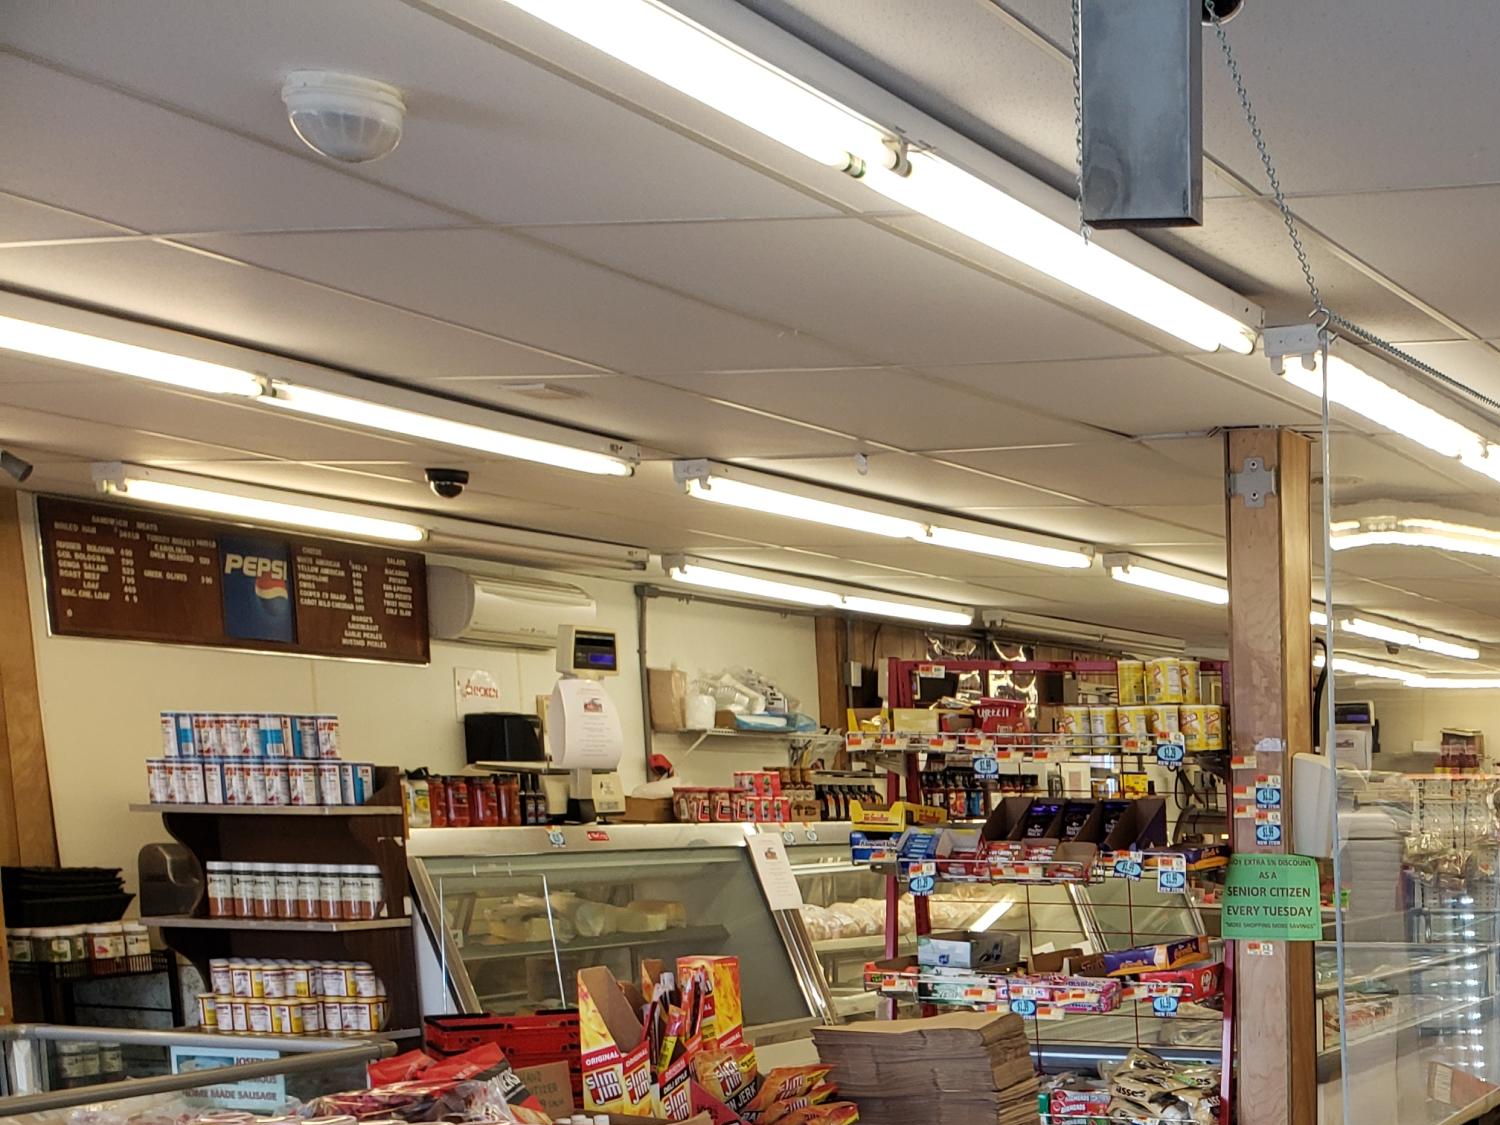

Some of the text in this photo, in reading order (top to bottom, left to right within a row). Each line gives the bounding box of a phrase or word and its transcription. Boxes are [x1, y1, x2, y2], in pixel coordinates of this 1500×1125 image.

[225, 553, 287, 581] PEPSI
[1278, 859, 1311, 867] DISCOUNT
[1227, 886, 1311, 898] SENIOR CITIZEN
[1227, 905, 1313, 917] EVERY TUESDAY
[585, 1051, 620, 1066] ORIGINAL
[626, 1048, 649, 1067] ORIGINAL
[210, 1089, 236, 1099] MADE
[238, 1091, 277, 1101] SAUSAGE
